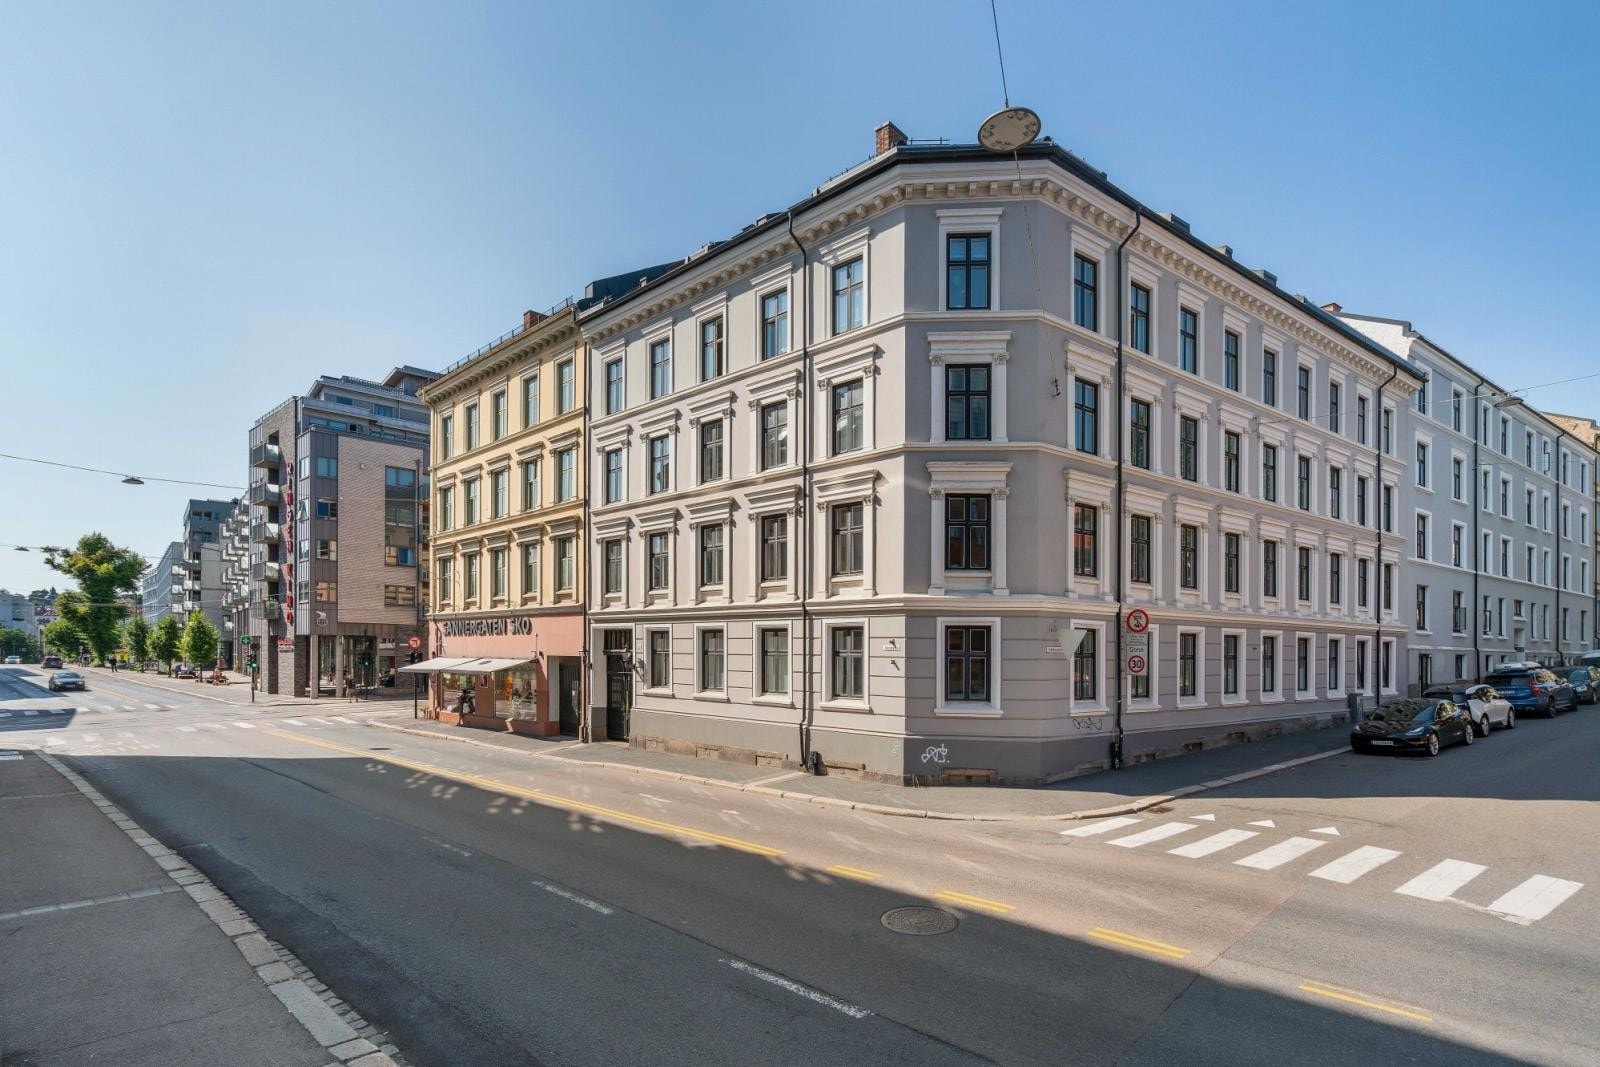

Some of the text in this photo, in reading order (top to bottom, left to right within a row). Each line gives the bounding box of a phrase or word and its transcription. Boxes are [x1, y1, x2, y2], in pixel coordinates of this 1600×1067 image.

[442, 616, 532, 636] SANNERGATEN SKO
[1131, 659, 1142, 669] 30
